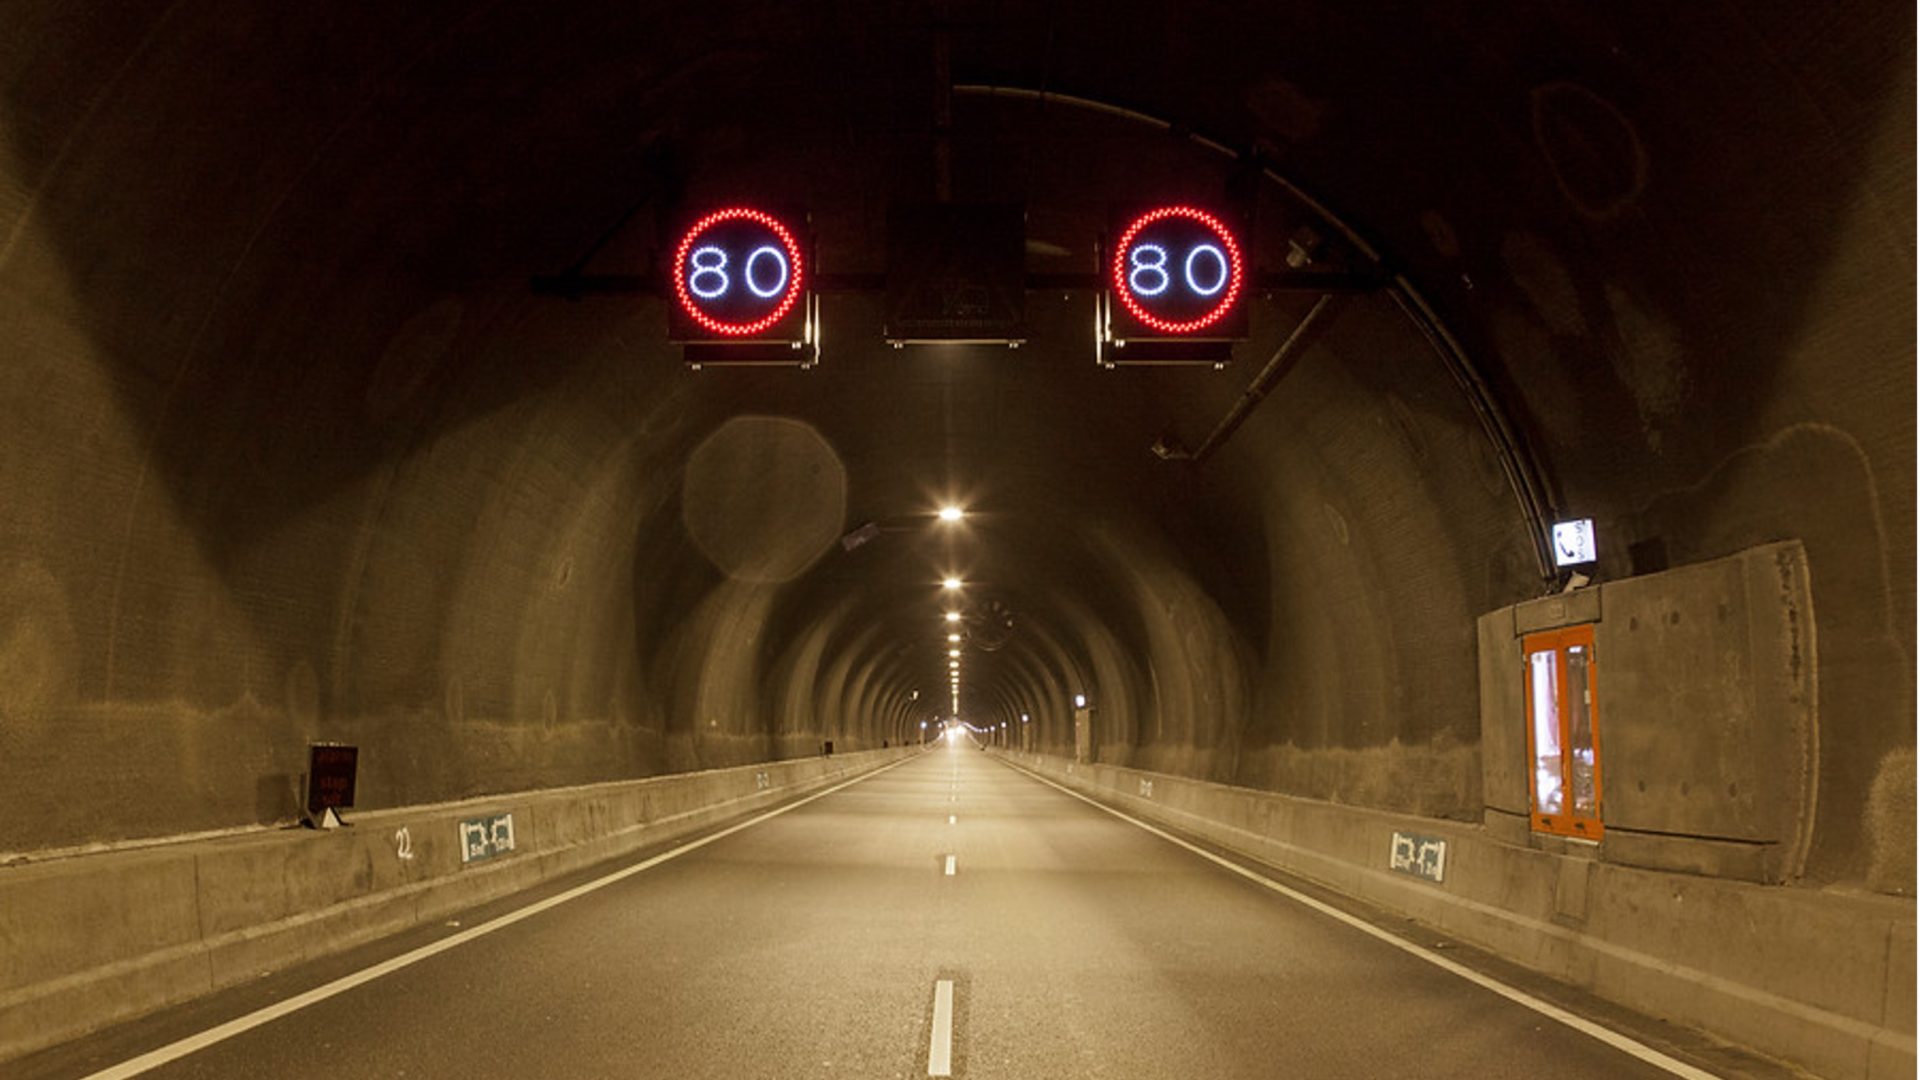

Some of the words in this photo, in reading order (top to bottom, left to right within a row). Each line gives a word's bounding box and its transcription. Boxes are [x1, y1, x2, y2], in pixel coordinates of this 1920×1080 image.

[689, 245, 788, 298] 80
[1129, 243, 1228, 296] 80
[1573, 520, 1586, 560] SOS
[395, 827, 413, 860] 22
